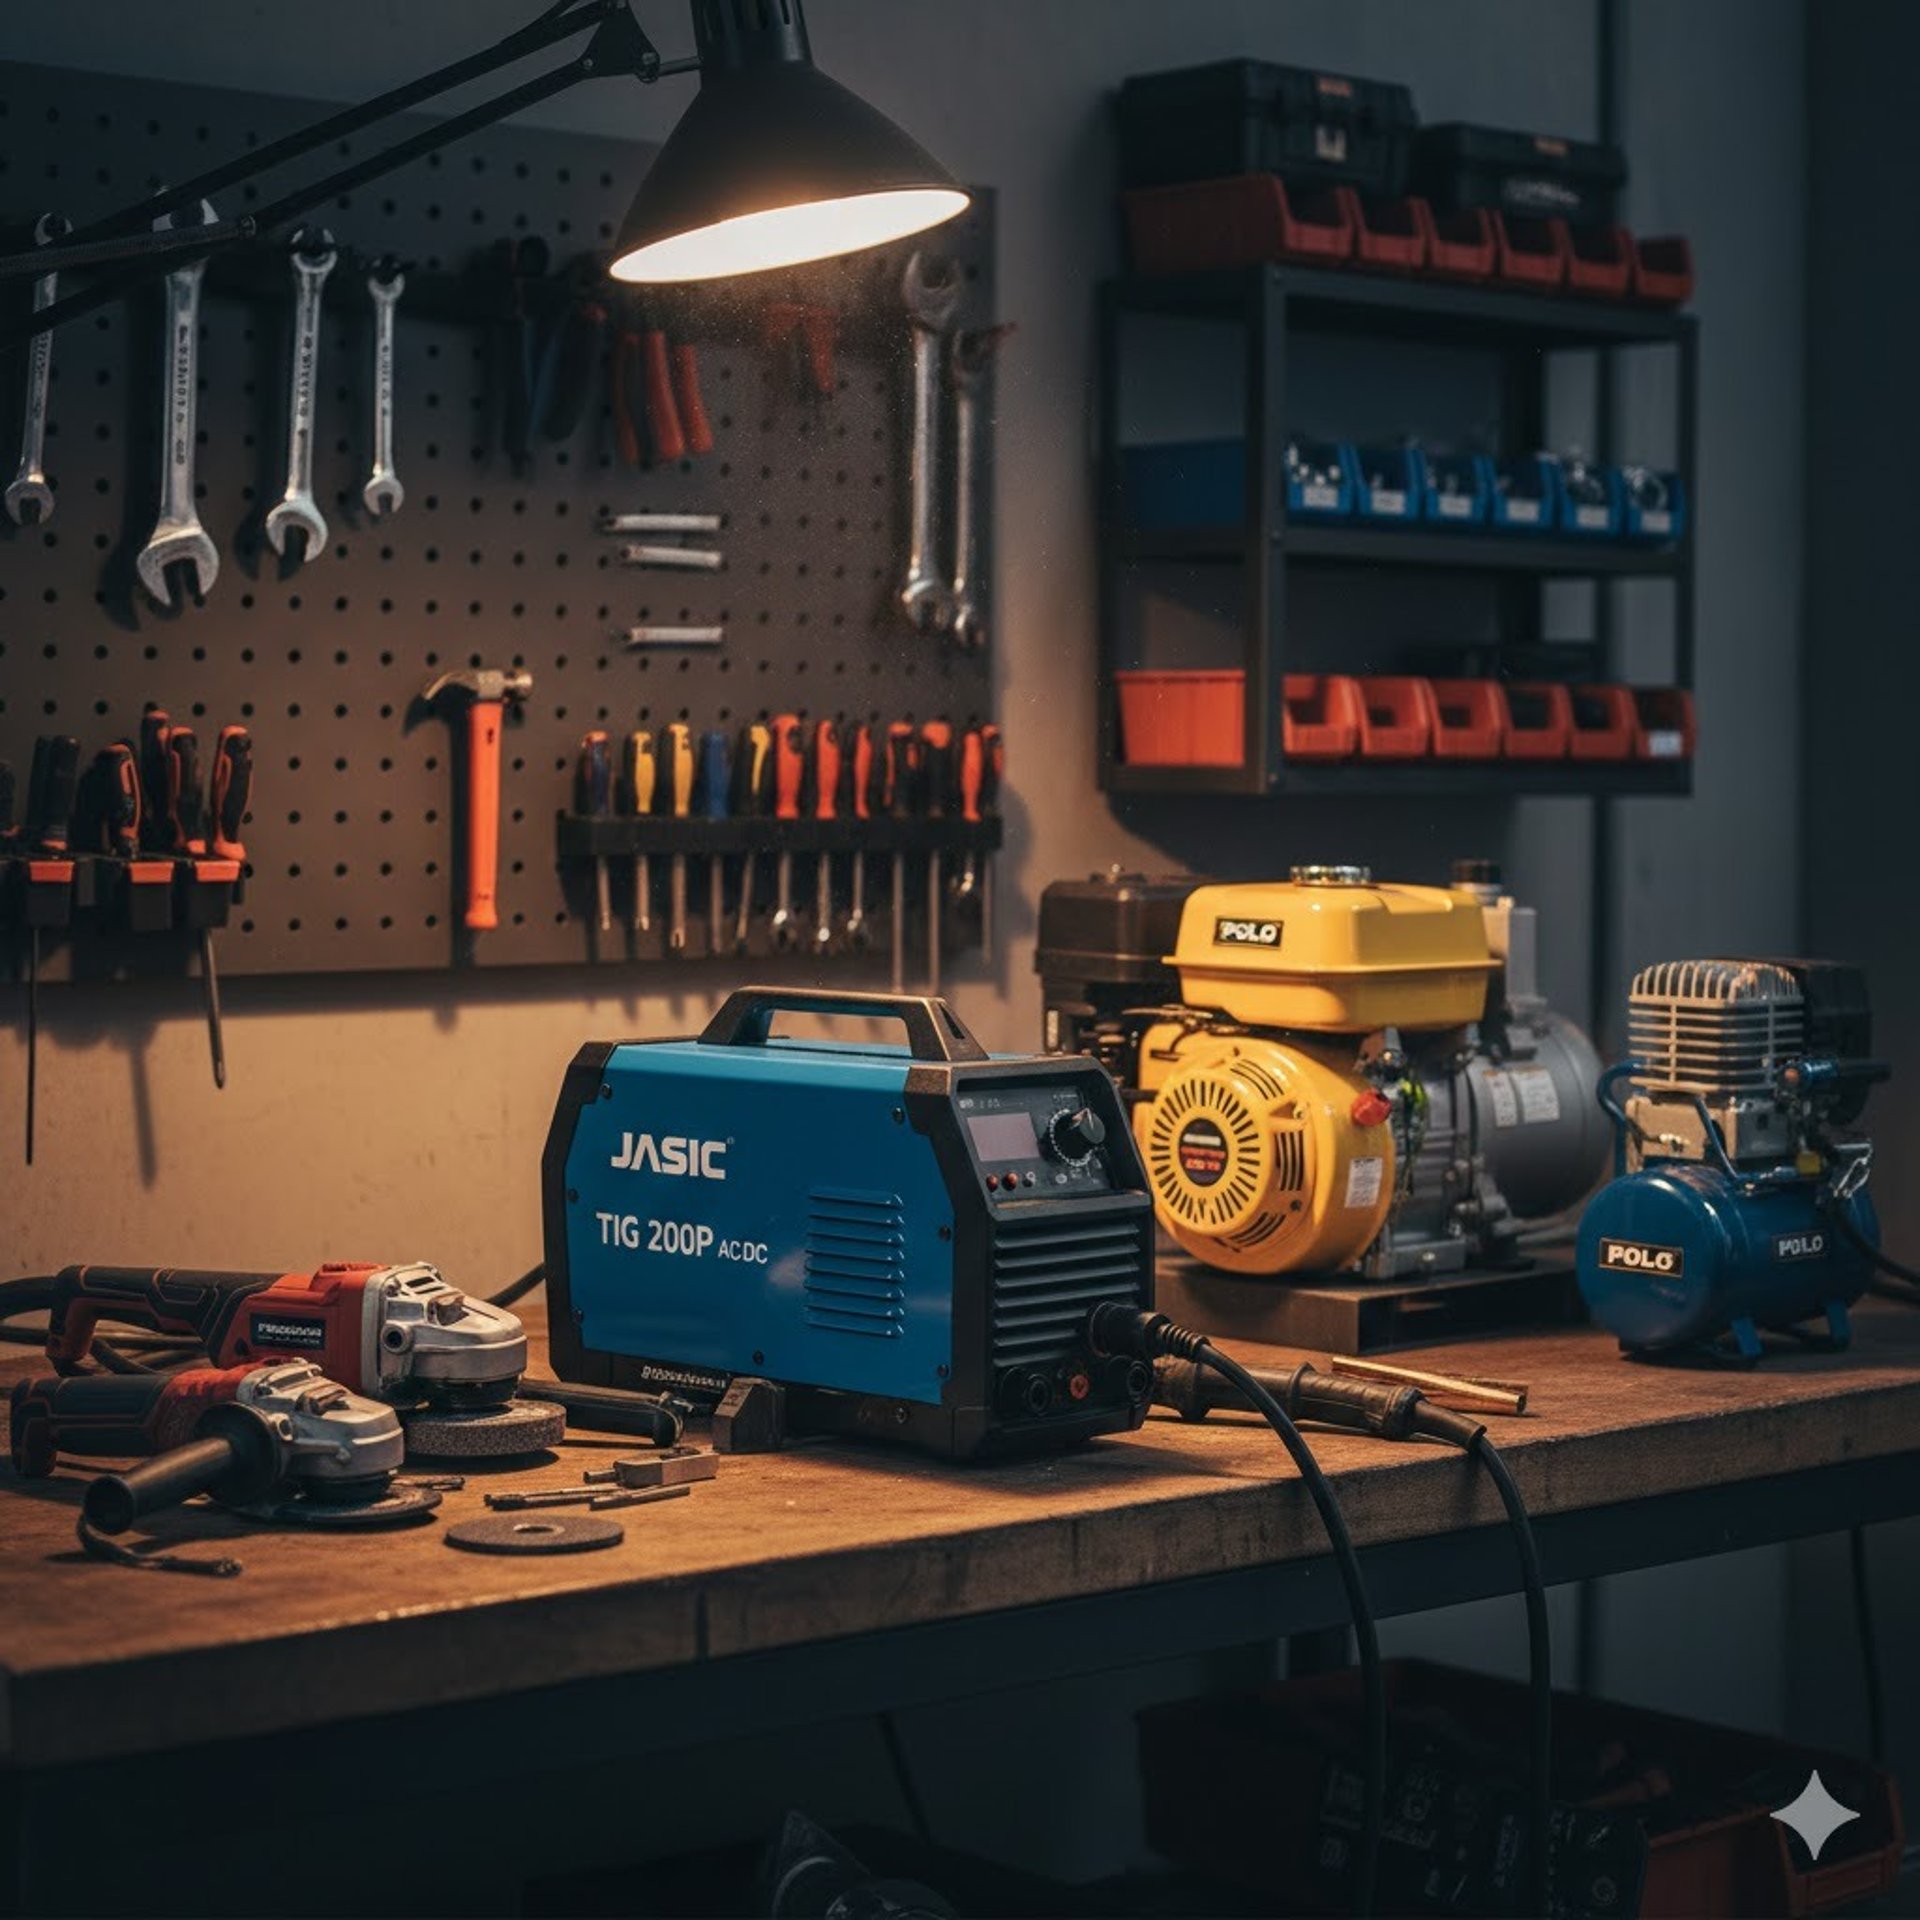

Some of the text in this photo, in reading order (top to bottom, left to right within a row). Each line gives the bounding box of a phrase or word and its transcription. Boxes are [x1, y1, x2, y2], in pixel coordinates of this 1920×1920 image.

[1219, 921, 1278, 944] POLO
[610, 1131, 727, 1180] JASIC
[595, 1211, 640, 1249] TIG
[647, 1219, 714, 1258] 200P
[1778, 1235, 1824, 1257] POLO
[1607, 1244, 1674, 1271] POLO
